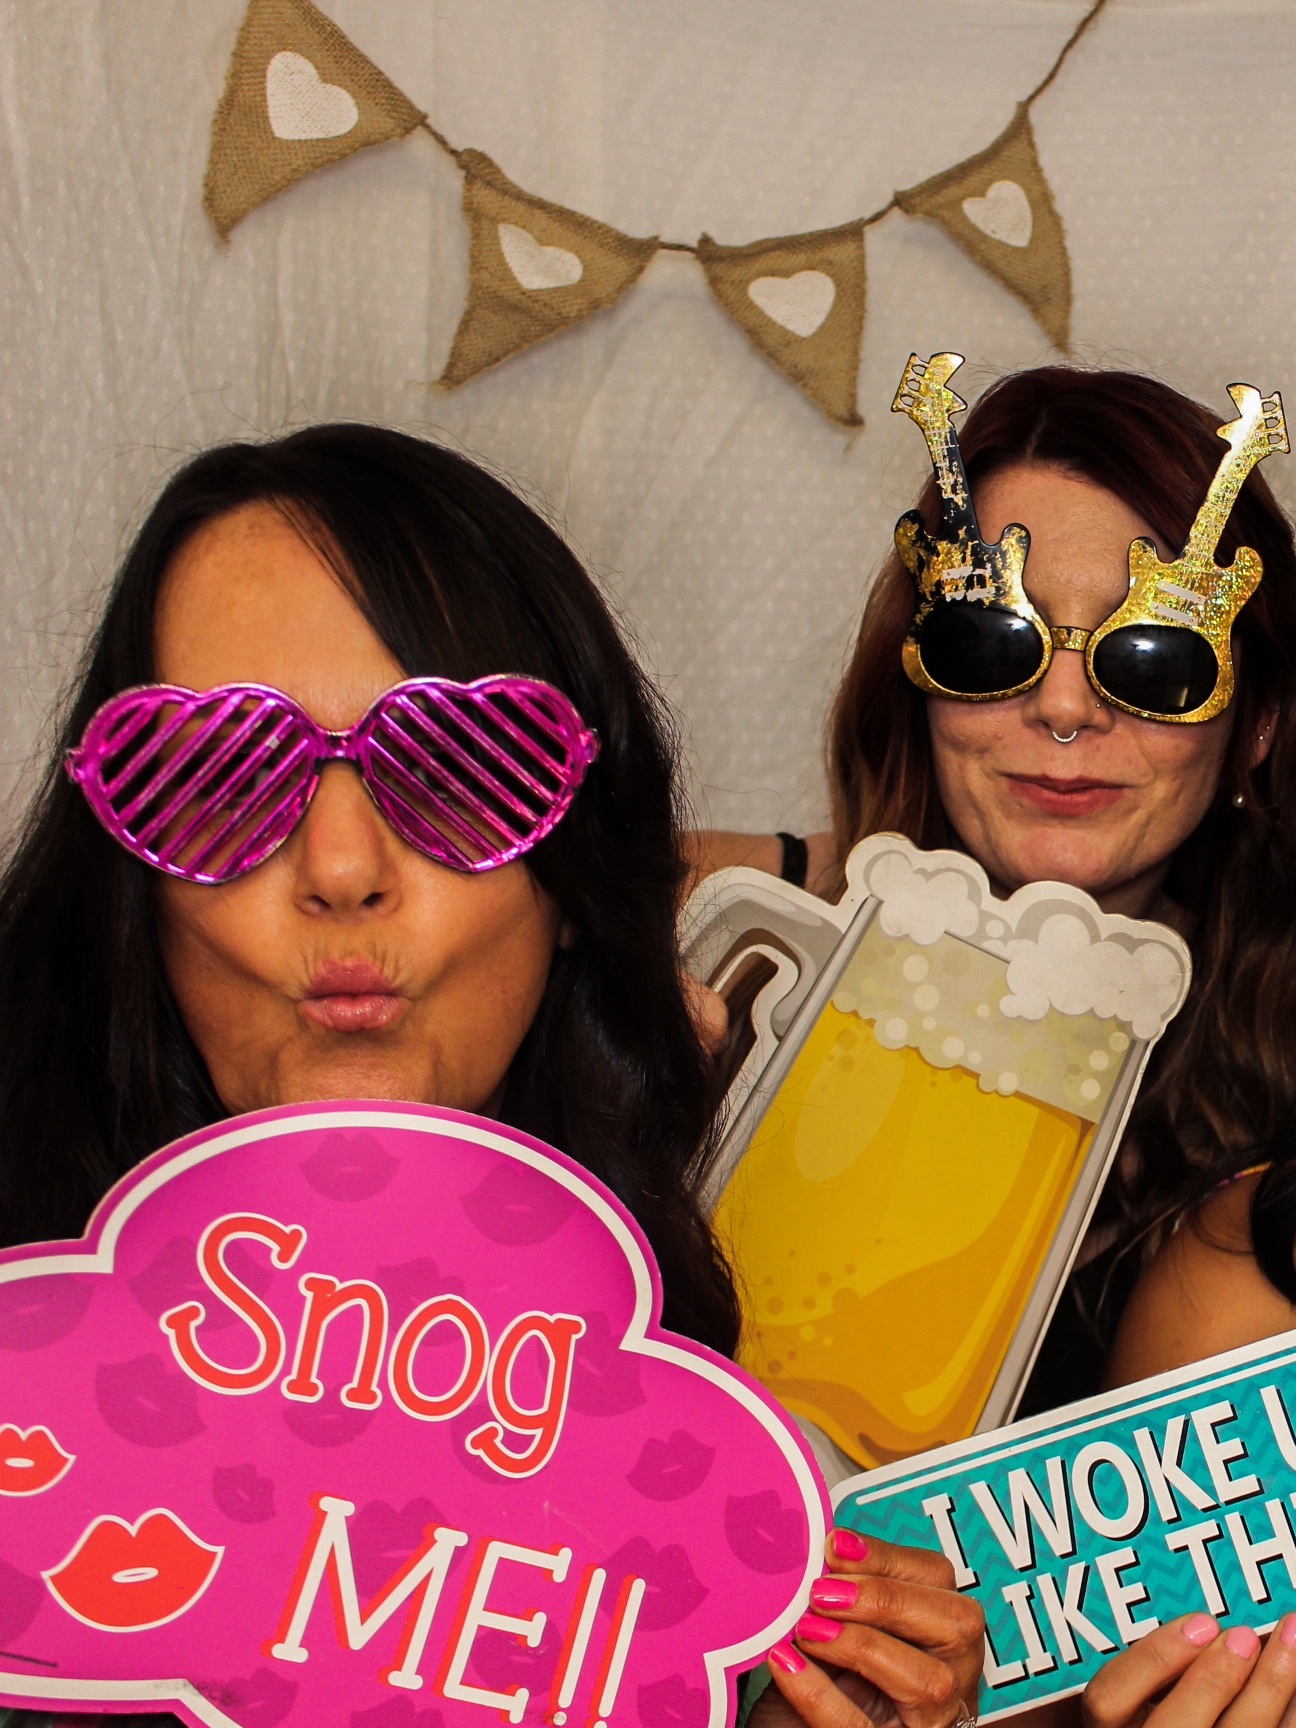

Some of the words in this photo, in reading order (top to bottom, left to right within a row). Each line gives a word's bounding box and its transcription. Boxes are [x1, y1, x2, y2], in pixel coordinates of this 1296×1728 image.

[160, 1212, 585, 1478] Snog
[264, 1492, 646, 1728] ME!!
[921, 1492, 979, 1592] I
[969, 1399, 1264, 1573] WOKE
